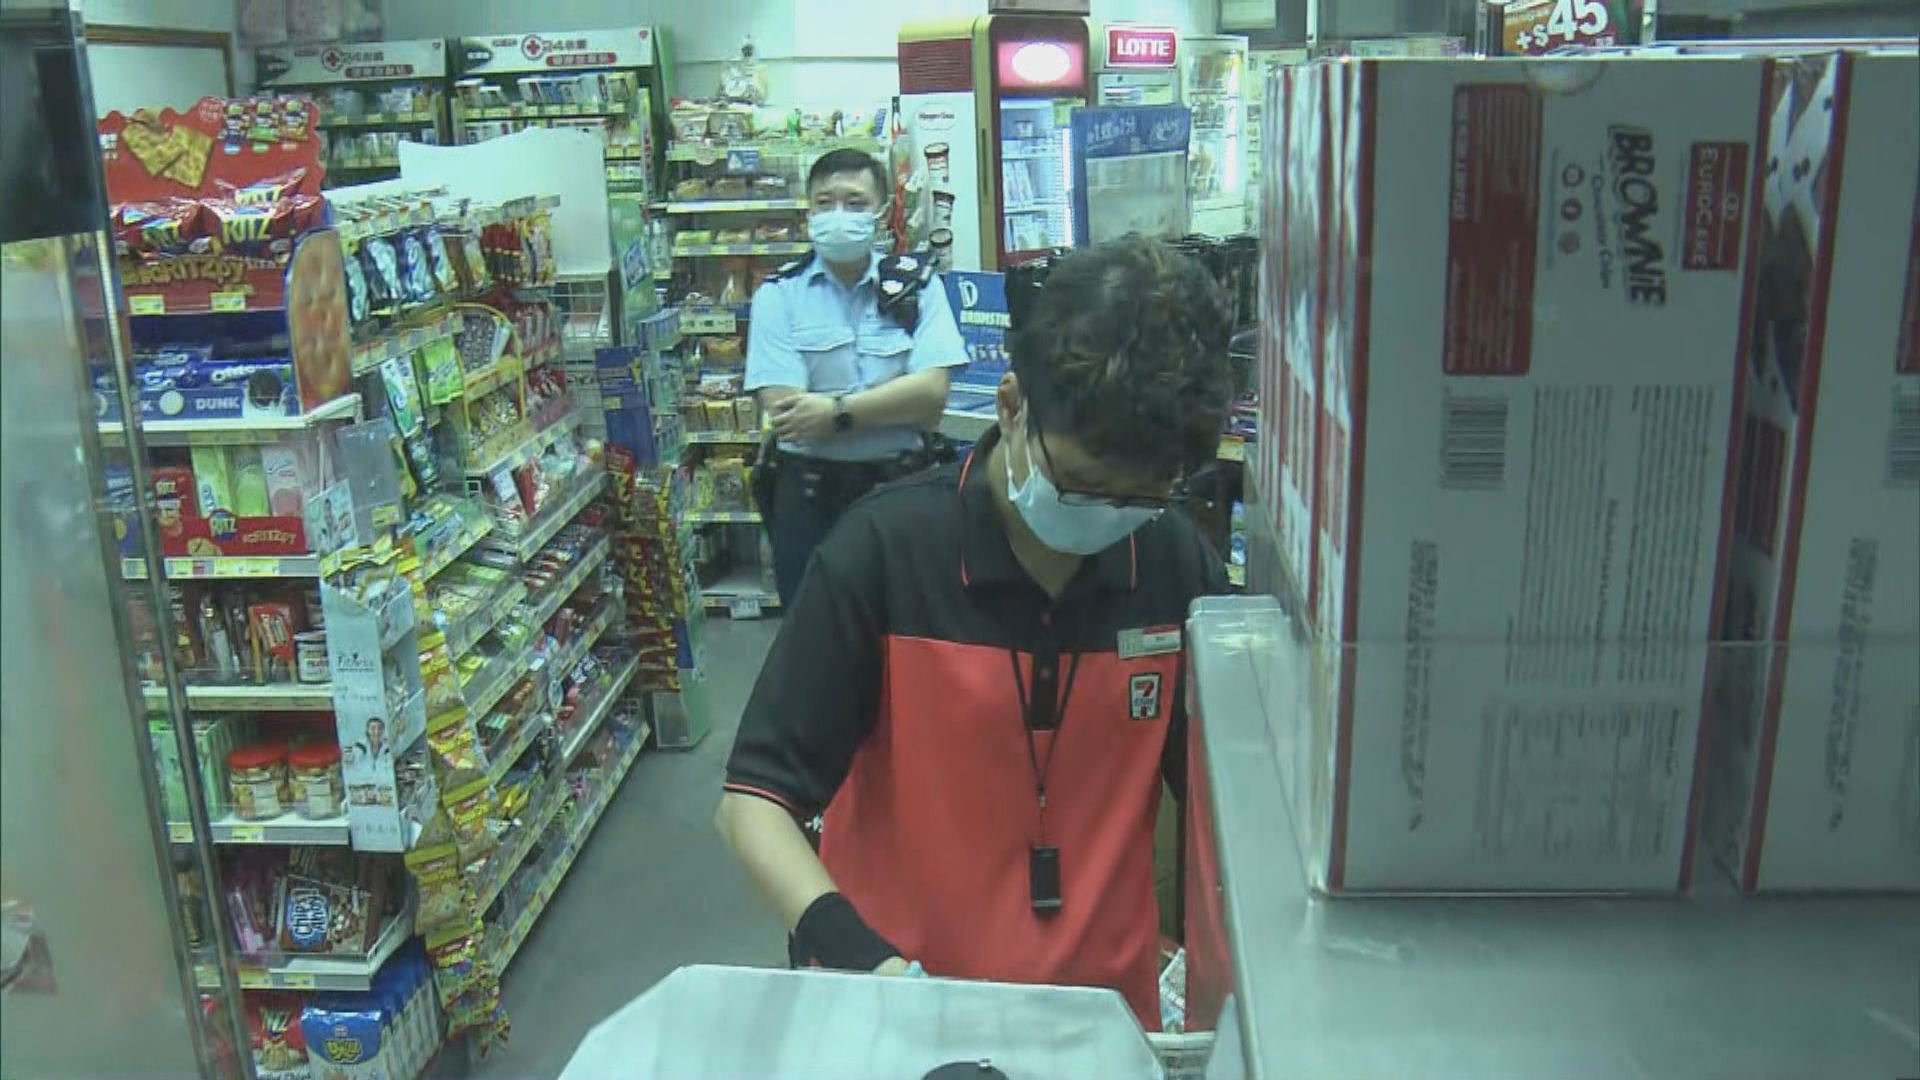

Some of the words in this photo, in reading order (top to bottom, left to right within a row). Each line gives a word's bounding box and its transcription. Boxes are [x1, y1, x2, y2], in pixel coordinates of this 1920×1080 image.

[1116, 37, 1170, 56] LOTTE
[222, 217, 272, 243] RITZ
[195, 397, 241, 410] DUNK
